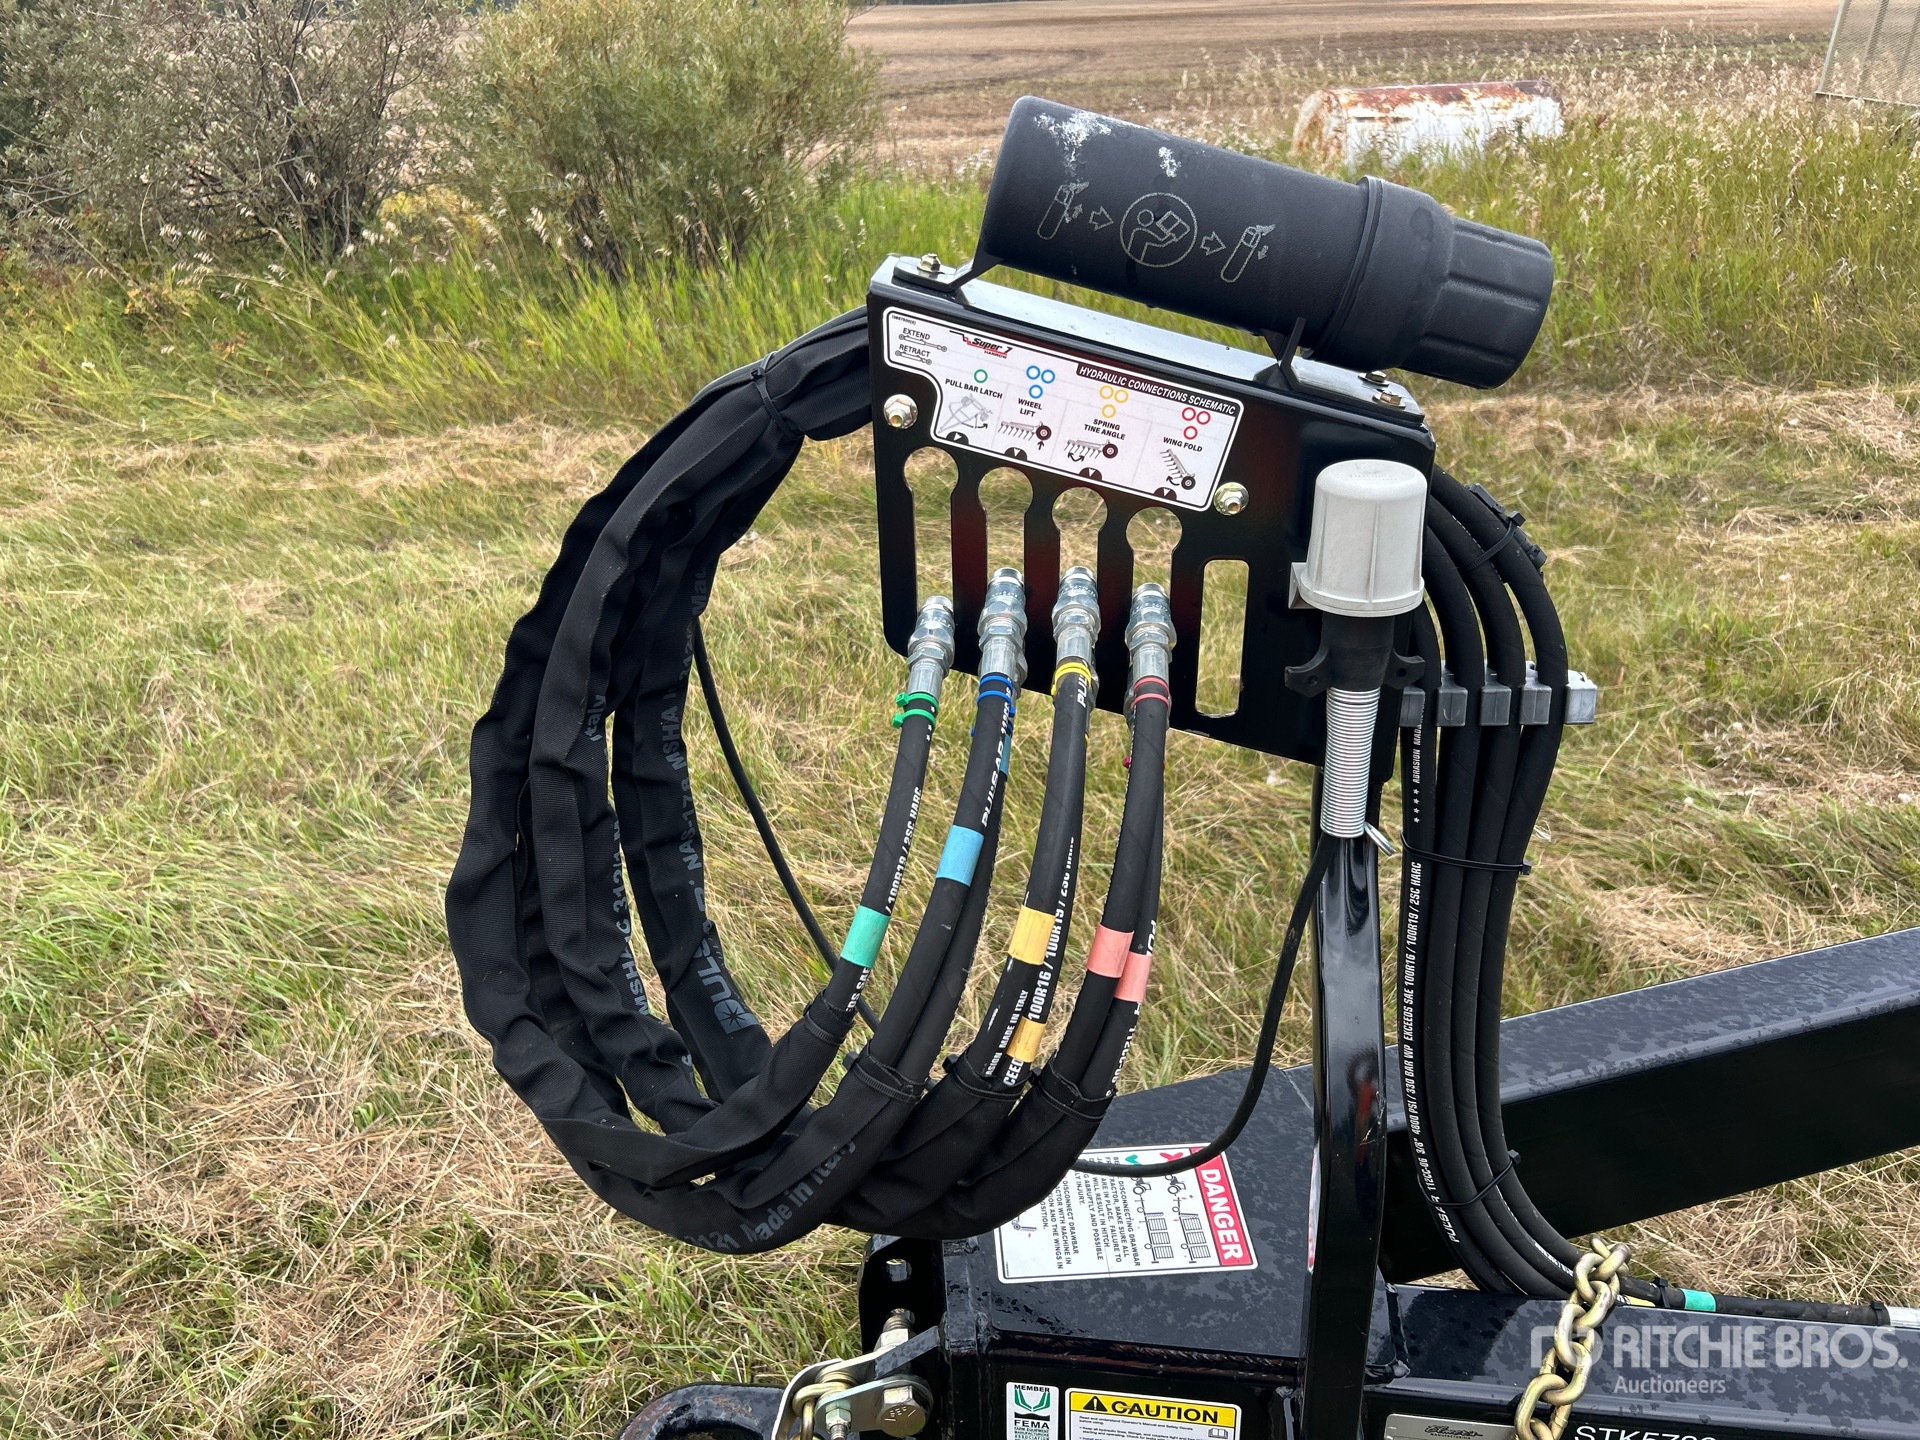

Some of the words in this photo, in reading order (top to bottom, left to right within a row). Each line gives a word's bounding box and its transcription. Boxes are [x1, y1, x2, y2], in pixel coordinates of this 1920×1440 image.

[902, 327, 931, 340] EXTEND
[899, 344, 931, 358] RETRACT
[972, 338, 1003, 350] Super
[1004, 346, 1014, 354] 7
[945, 378, 963, 389] PULL
[963, 383, 979, 393] BAR
[979, 388, 1003, 399] LATCH
[1079, 366, 1128, 387] HYDRAULIC
[1128, 378, 1189, 404] CONNECTIONS
[1188, 394, 1236, 415] SCHEMATIC
[1018, 398, 1043, 410] WHEEL
[1020, 408, 1036, 418] LIFT
[1084, 424, 1101, 436] TINE
[1101, 428, 1126, 441] ANGLE
[1093, 418, 1121, 431] SPRING
[1163, 436, 1183, 448] WING
[1183, 442, 1203, 453] FOLD
[661, 705, 687, 771] MSHA
[1412, 749, 1421, 784] ABRASION
[1410, 861, 1422, 886] HARC
[1409, 887, 1421, 905] 2SC
[1406, 912, 1419, 945] 100R19
[1404, 953, 1416, 986] 100R16
[1028, 971, 1052, 1020] 100R16
[1403, 988, 1414, 1008] SAE
[999, 1025, 1015, 1049] MADE
[1010, 1013, 1020, 1024] IN
[1015, 989, 1028, 1011] ITALY
[1403, 1005, 1414, 1041] EXCEEDS
[1403, 1044, 1413, 1059] WP
[1404, 1060, 1414, 1077] BAR
[1405, 1078, 1415, 1094] 330
[1407, 1100, 1418, 1114] PSI
[1409, 1115, 1421, 1135] 4800
[1076, 1181, 1086, 1205] INJURY.
[1092, 1177, 1100, 1192] WILL
[1101, 1178, 1109, 1190] ARE
[1110, 1178, 1119, 1205] RACTOR,
[784, 1181, 814, 1208] in
[1055, 1186, 1063, 1206] ACTOR
[1084, 1180, 1095, 1212] ABRUPTLY
[1095, 1193, 1105, 1217] RESULT
[1105, 1200, 1114, 1222] PLACE.
[1115, 1206, 1124, 1224] MAKE
[1201, 1168, 1243, 1260] DANGER
[1040, 1201, 1049, 1230] OSITION.
[1049, 1209, 1057, 1223] AND
[1058, 1207, 1066, 1224] WITH
[1062, 1180, 1074, 1221] DISCONNECT
[1068, 1222, 1080, 1255] DRAWBAR
[1090, 1213, 1098, 1227] AND
[1119, 1181, 1134, 1232] DISCONNECTING
[1129, 1234, 1141, 1266] DRAWBAR
[1051, 1224, 1060, 1237] THE
[1060, 1225, 1071, 1256] MACHINE
[1101, 1227, 1111, 1248] HITCH
[1110, 1225, 1121, 1252] FAILURE
[1119, 1227, 1128, 1244] SURE
[1054, 1238, 1063, 1261] WINGS
[1093, 1228, 1104, 1261] POSSIBLE
[1057, 1261, 1064, 1270] IN
[1065, 1257, 1072, 1265] IN
[1115, 1253, 1122, 1263] TO
[1014, 1384, 1050, 1393] MEMBER
[1111, 1400, 1219, 1424] CAUTION
[1014, 1420, 1050, 1430] FEMA
